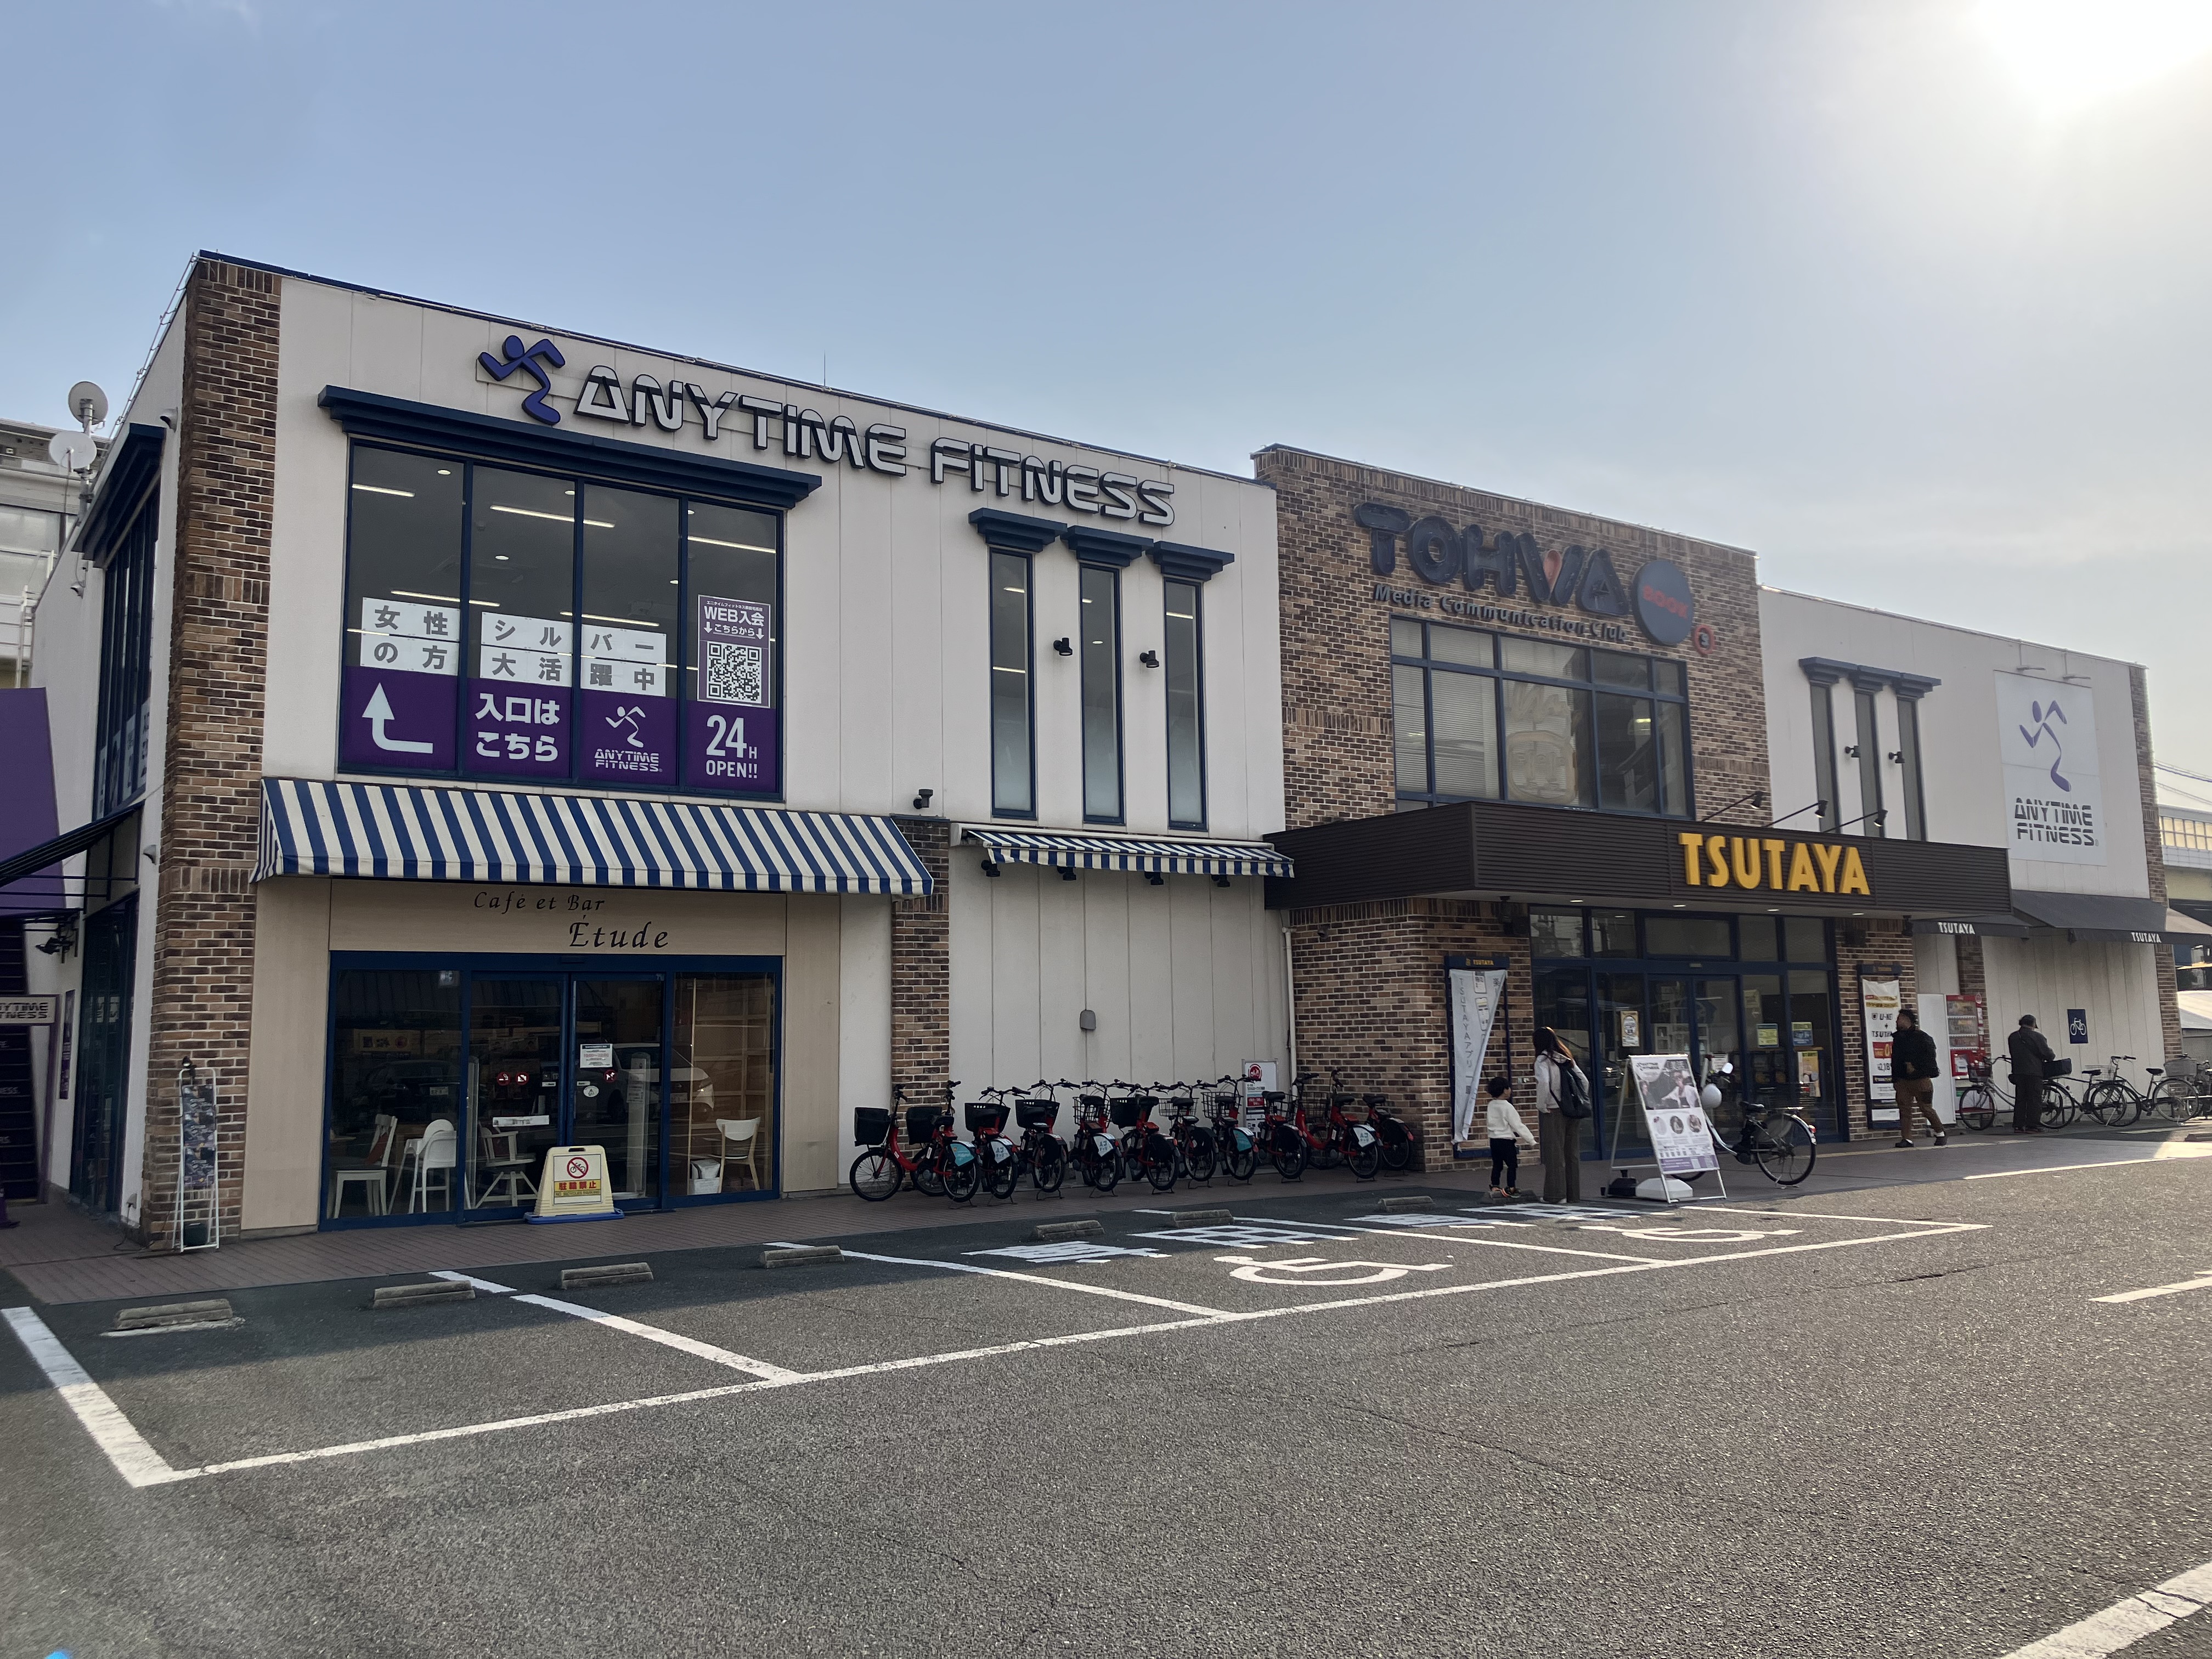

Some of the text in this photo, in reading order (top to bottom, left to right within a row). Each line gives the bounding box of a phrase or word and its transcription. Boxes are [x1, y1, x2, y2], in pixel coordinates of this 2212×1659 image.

[574, 365, 1175, 526] ANYTIME FITNESS
[374, 605, 448, 636] 女性
[704, 605, 765, 627] WEB入会
[1374, 583, 1628, 641] Media Communication Club
[495, 619, 654, 651] シルバー
[714, 623, 755, 636] こちらから
[374, 642, 448, 670] の方
[492, 652, 654, 691] 大活躍中
[475, 692, 560, 725] 入口は
[476, 731, 558, 762] こちら
[594, 748, 659, 763] ANYTIME
[595, 759, 659, 772] FITNESS
[706, 759, 758, 778] OPEN!!
[2015, 797, 2093, 827] ANYTIME
[2016, 822, 2095, 847] FITNESS
[1678, 832, 1871, 896] TSUTAYA
[473, 891, 605, 915] Café et Bar
[569, 915, 668, 949] Étude
[1937, 922, 1976, 935] TSUTAYA
[2131, 932, 2163, 944] TSUTAYA
